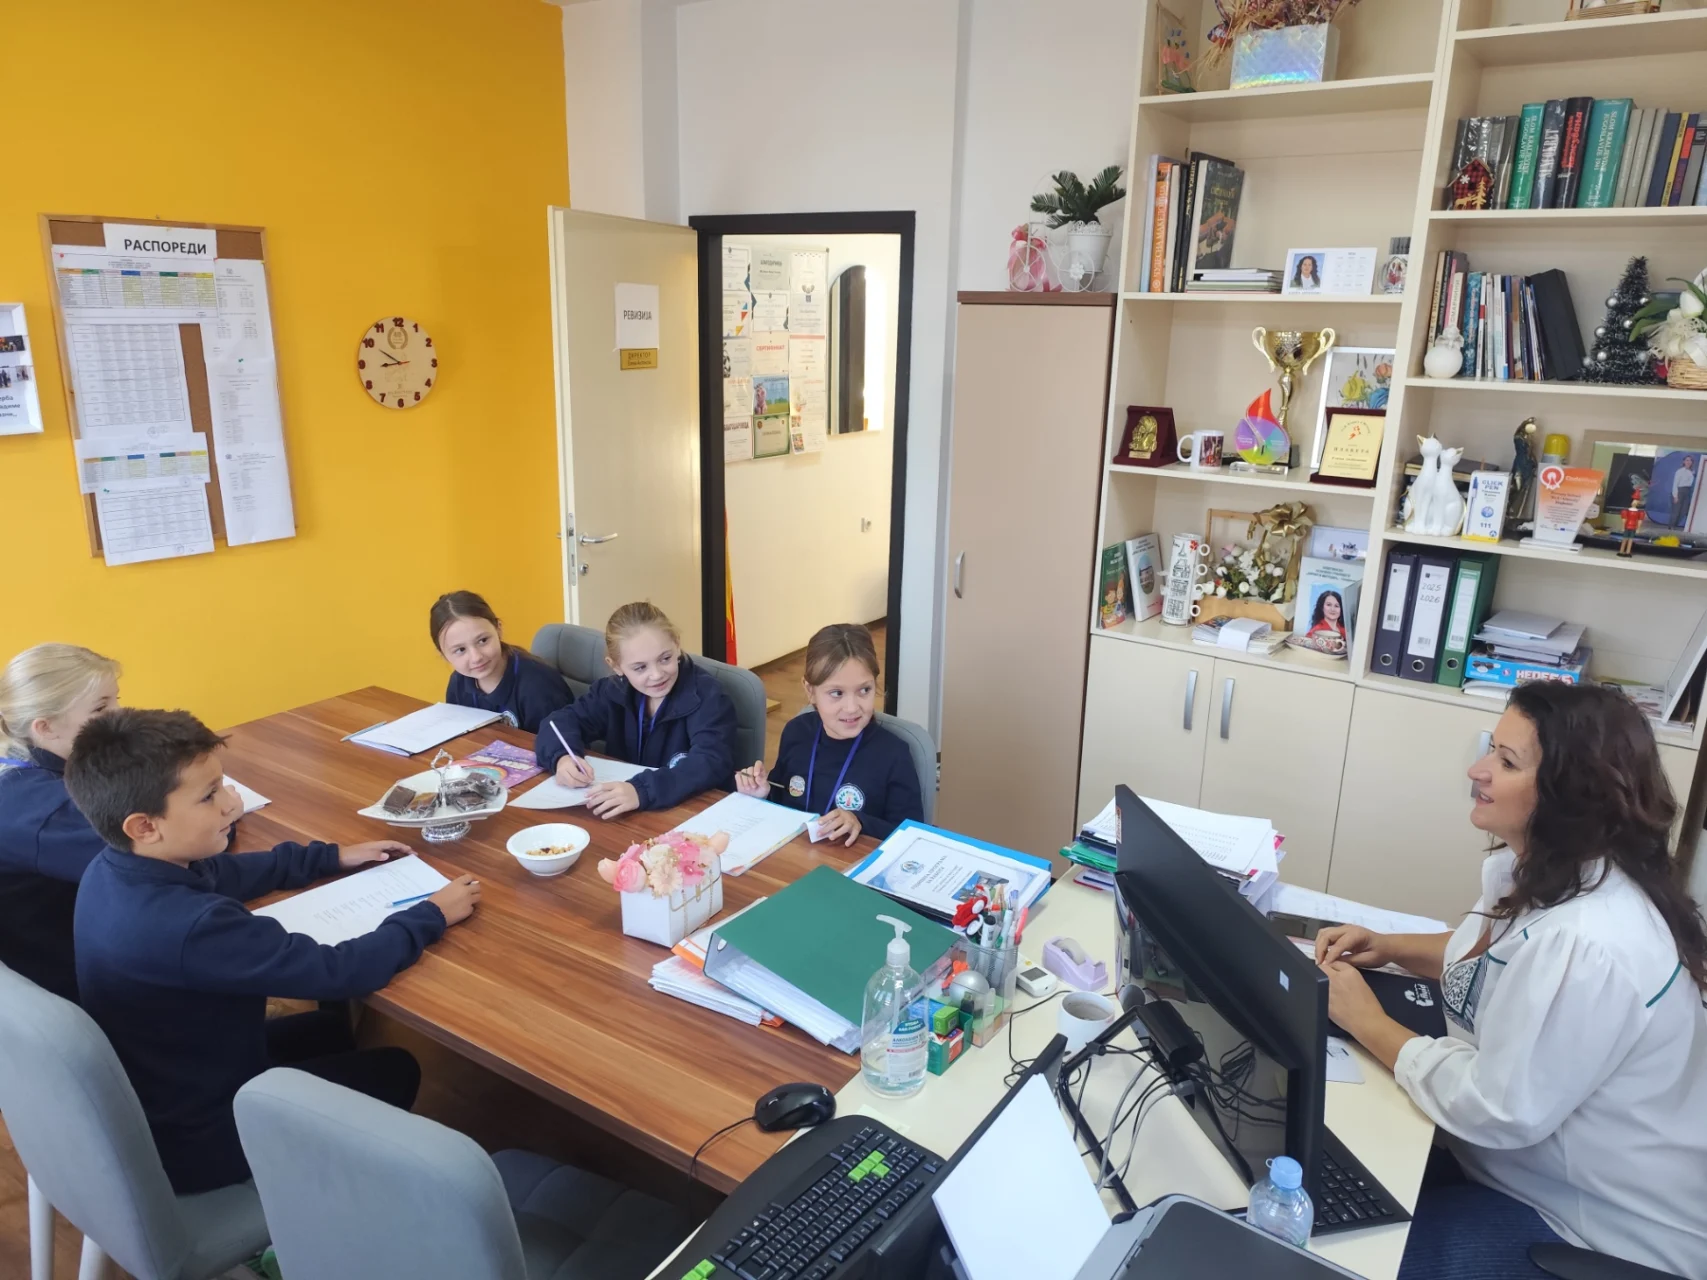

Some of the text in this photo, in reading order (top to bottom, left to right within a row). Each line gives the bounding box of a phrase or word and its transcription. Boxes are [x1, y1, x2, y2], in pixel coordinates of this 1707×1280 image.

[124, 239, 207, 255] РАСПОРЕДИ
[624, 310, 652, 320] РЕВИЗИЈА
[392, 317, 404, 327] 12
[374, 323, 384, 333] 11
[413, 323, 418, 332] 1
[363, 338, 375, 348] 10
[425, 338, 432, 347] 2
[358, 359, 366, 370] 9
[431, 358, 438, 368] 3
[366, 380, 373, 390] 8
[425, 378, 432, 388] 4
[379, 393, 386, 403] 7
[414, 392, 421, 401] 5
[397, 398, 404, 408] 6
[1422, 583, 1442, 592] 2025
[1419, 594, 1441, 604] 2026
